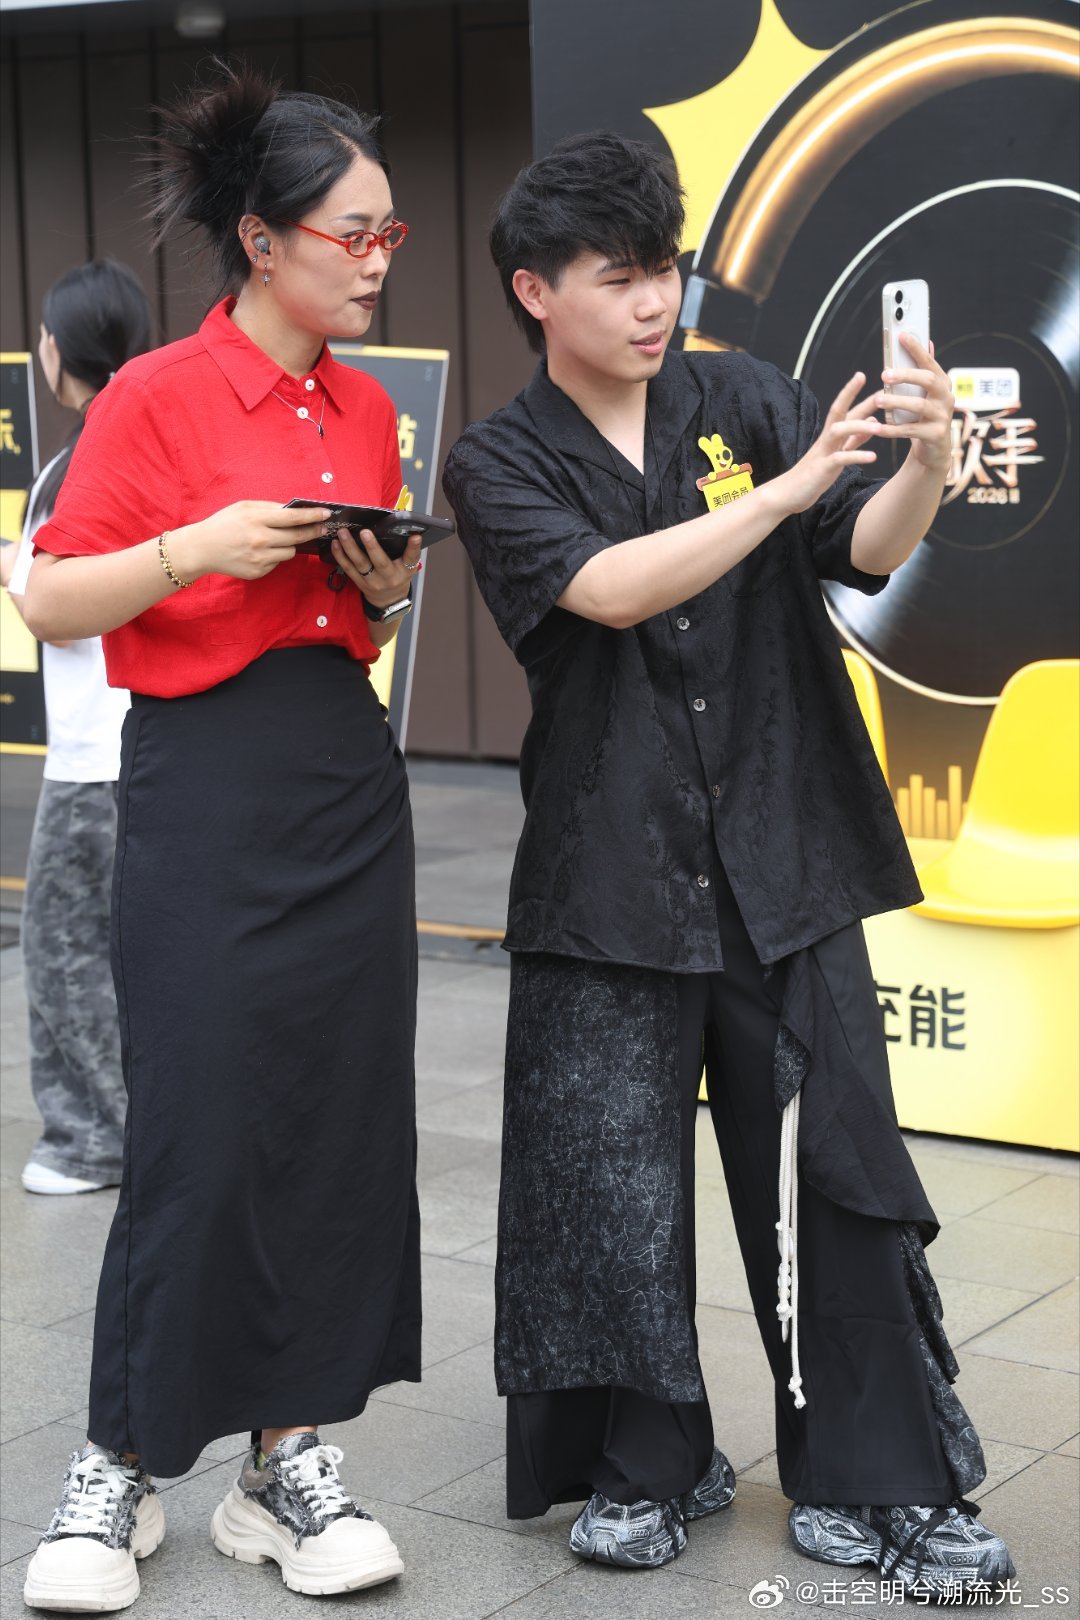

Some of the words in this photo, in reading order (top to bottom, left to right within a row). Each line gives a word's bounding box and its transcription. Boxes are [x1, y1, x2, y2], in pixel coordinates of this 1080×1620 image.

[978, 379, 1013, 398] 美团
[712, 486, 749, 508] 美团会员
